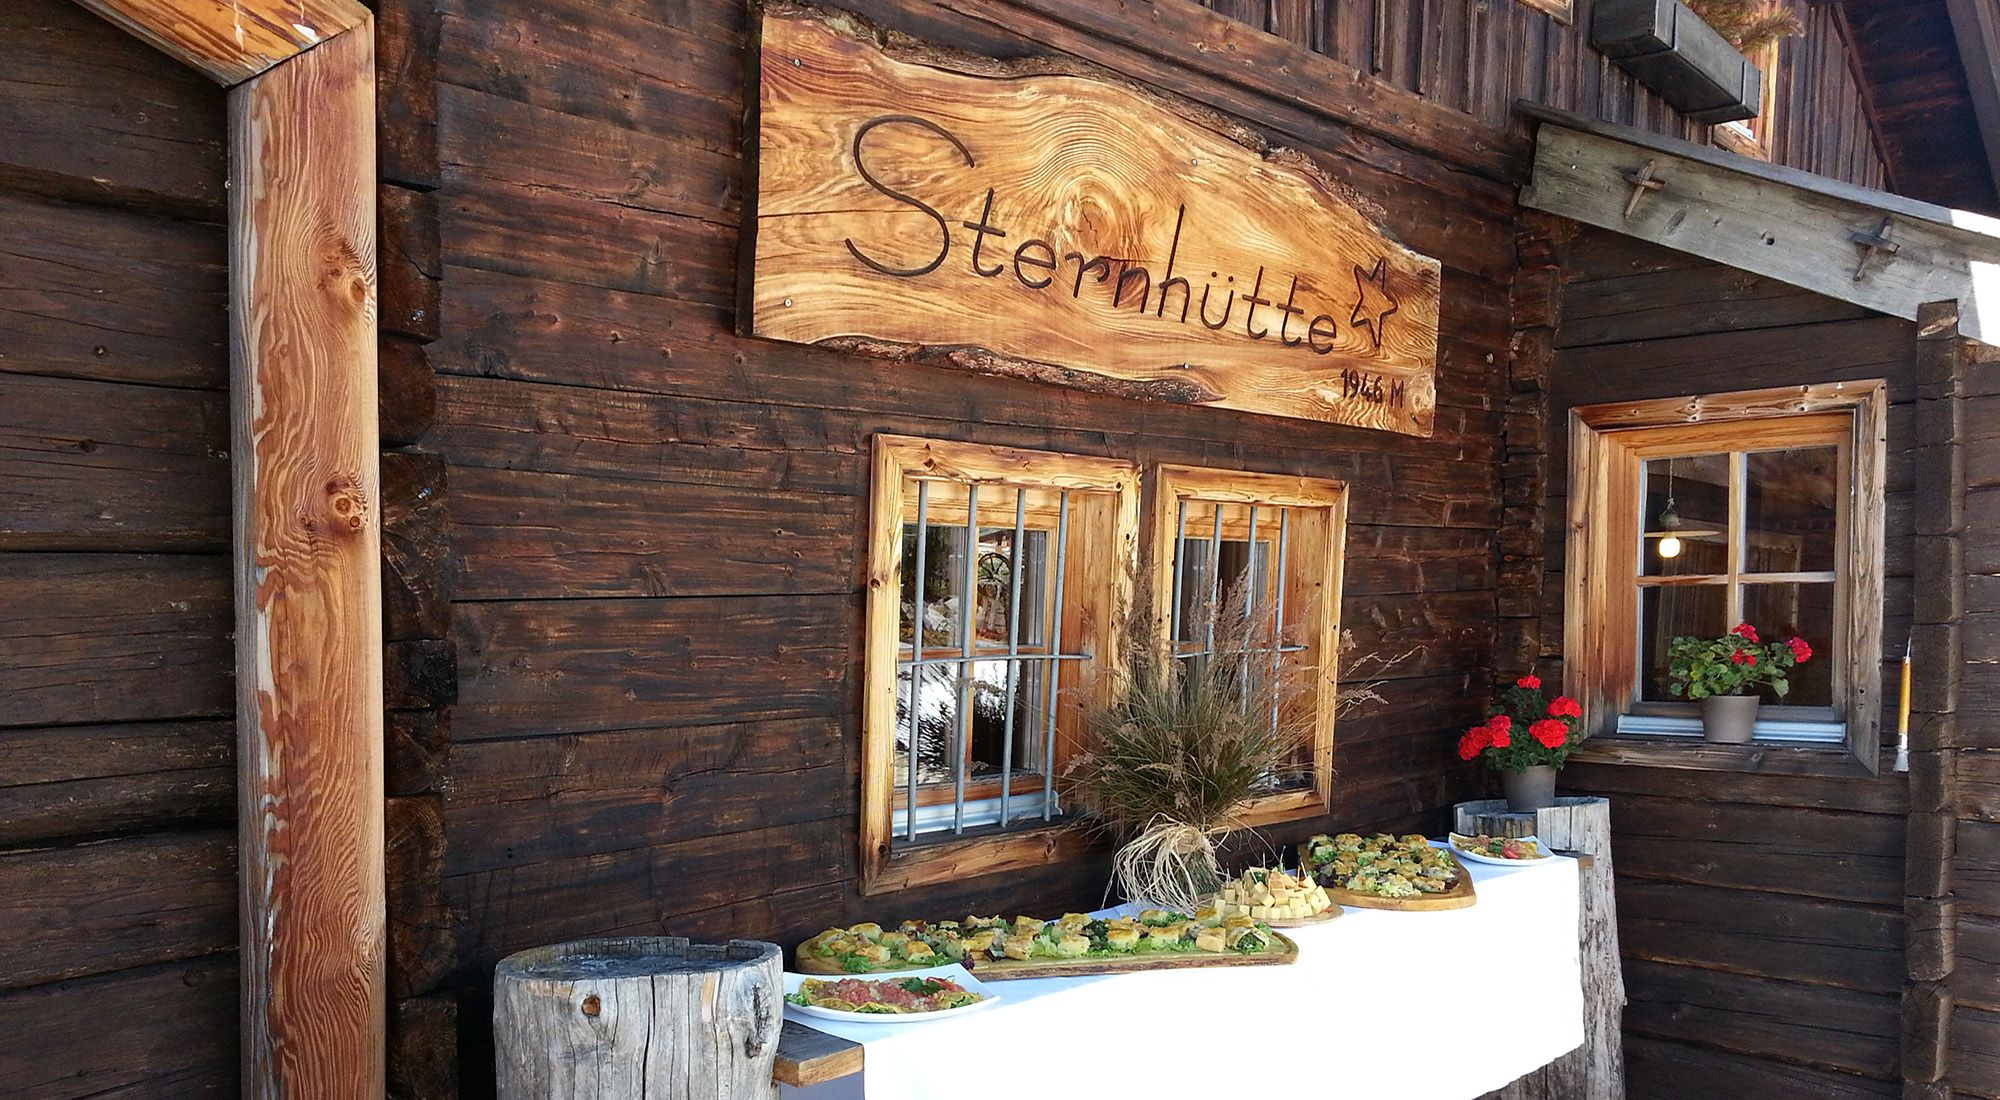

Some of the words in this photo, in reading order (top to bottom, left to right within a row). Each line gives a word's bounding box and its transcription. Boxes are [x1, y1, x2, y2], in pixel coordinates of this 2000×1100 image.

[844, 114, 1337, 354] Sternhütte
[1340, 368, 1383, 403] 1946
[1390, 377, 1404, 408] M
